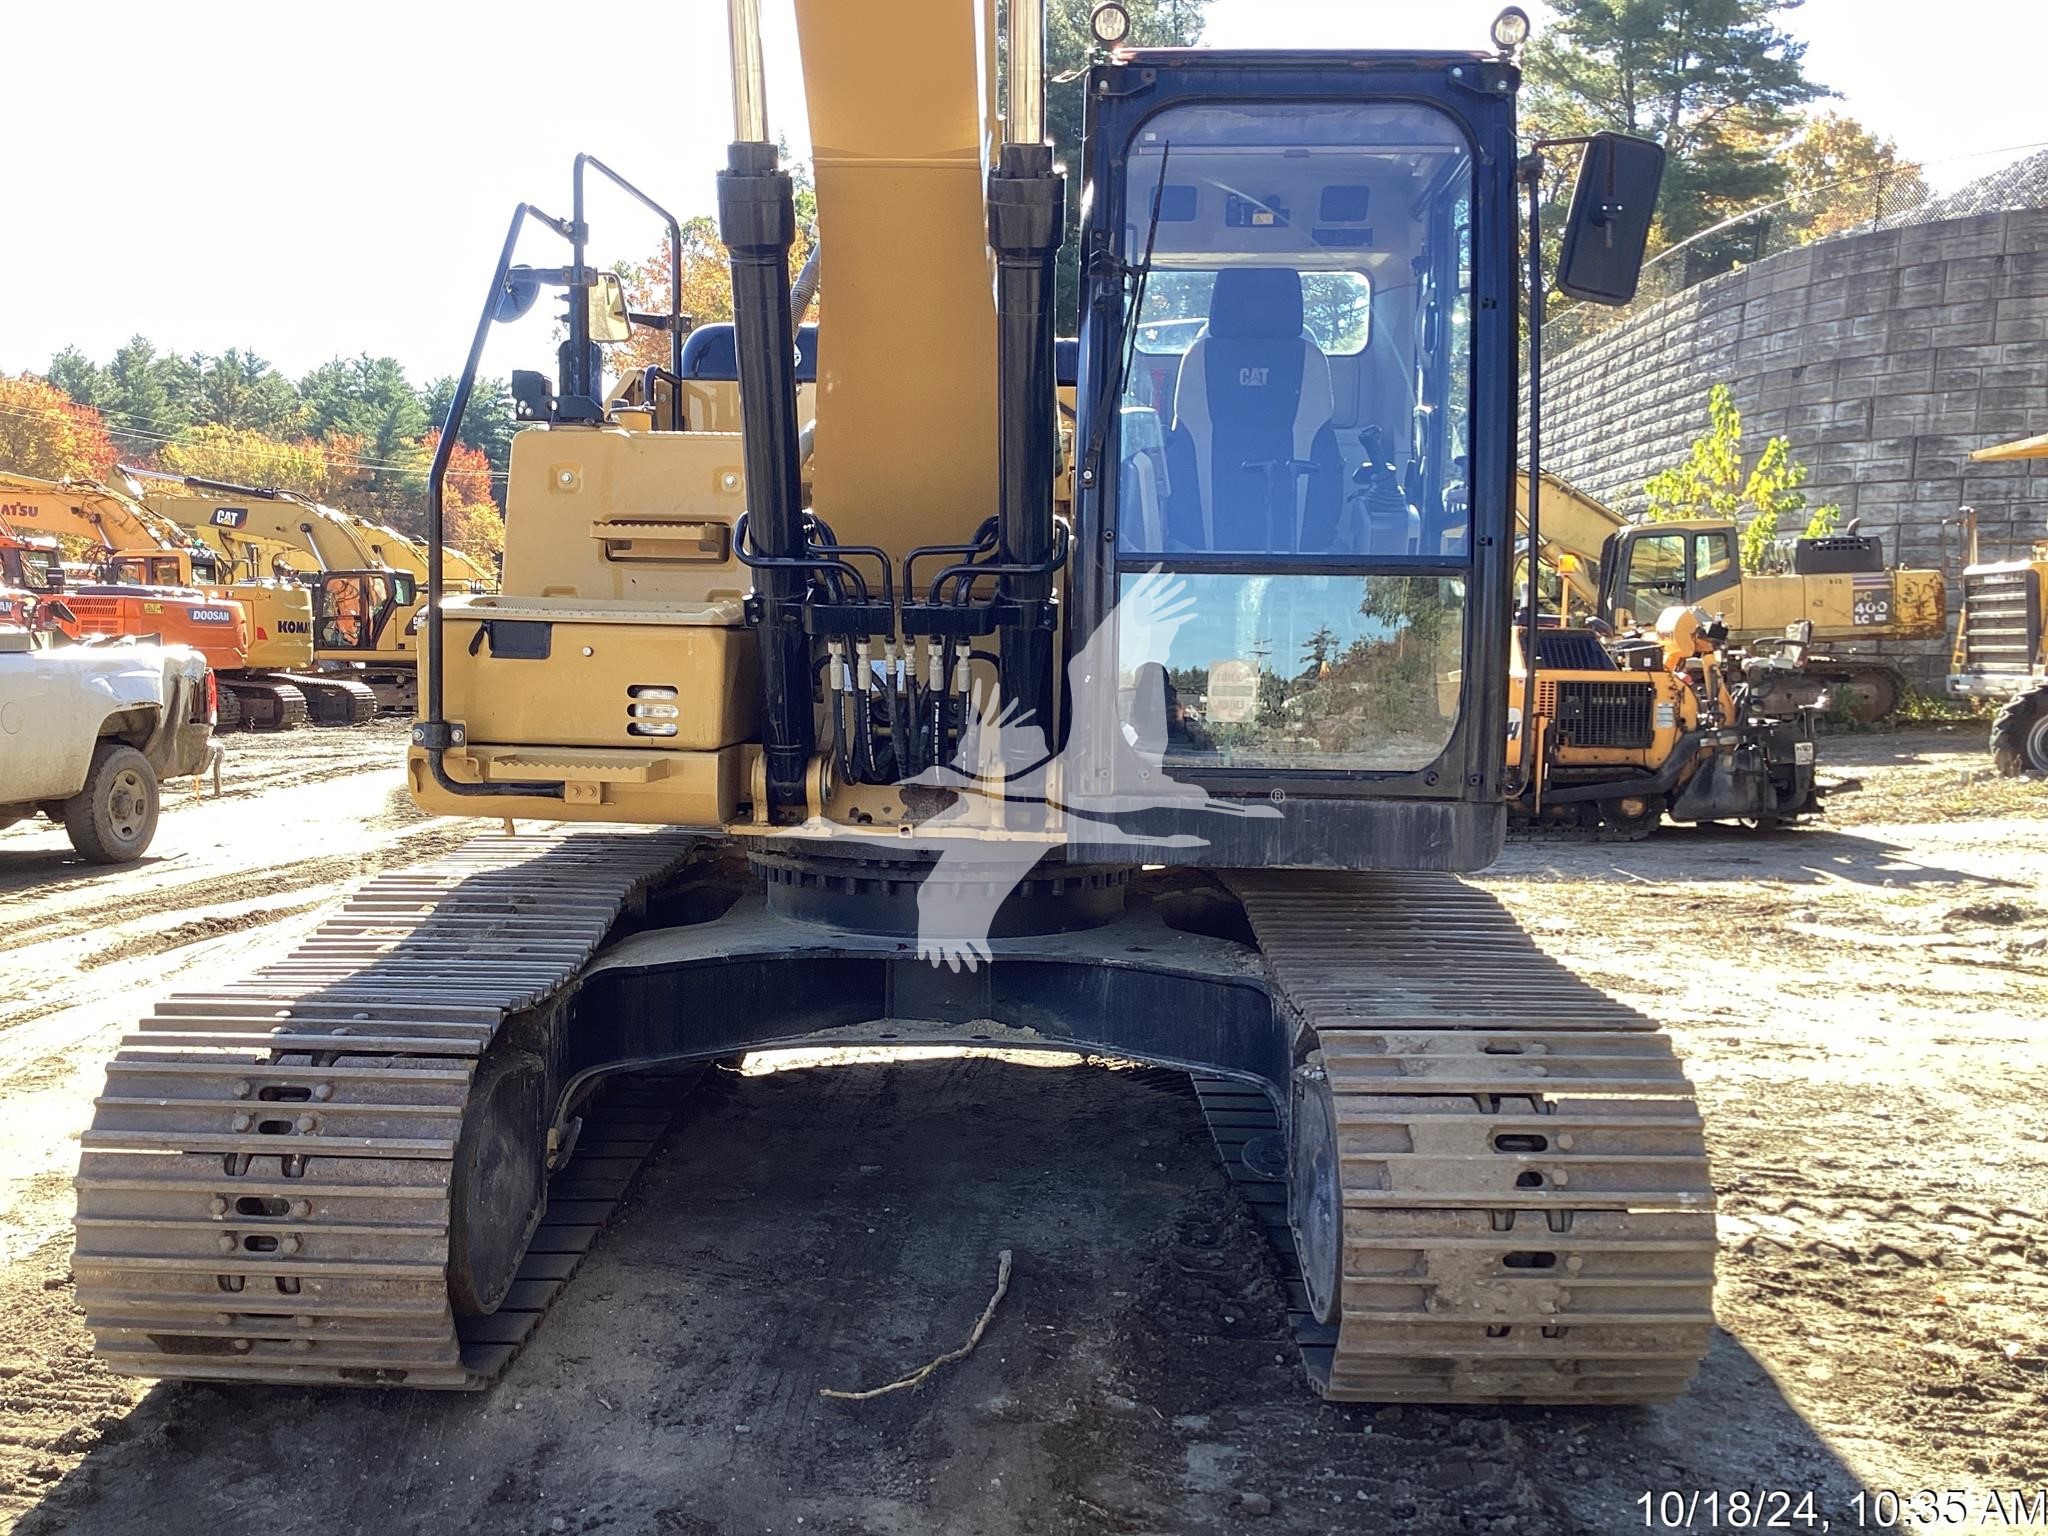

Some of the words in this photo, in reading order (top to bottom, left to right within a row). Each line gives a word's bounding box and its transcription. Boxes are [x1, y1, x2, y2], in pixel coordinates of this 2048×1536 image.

[1239, 367, 1270, 386] CAT
[0, 504, 39, 517] ATSU
[216, 509, 239, 526] CAT
[1855, 601, 1888, 614] 400
[192, 610, 230, 621] DOOSAN
[277, 620, 311, 634] KOMA
